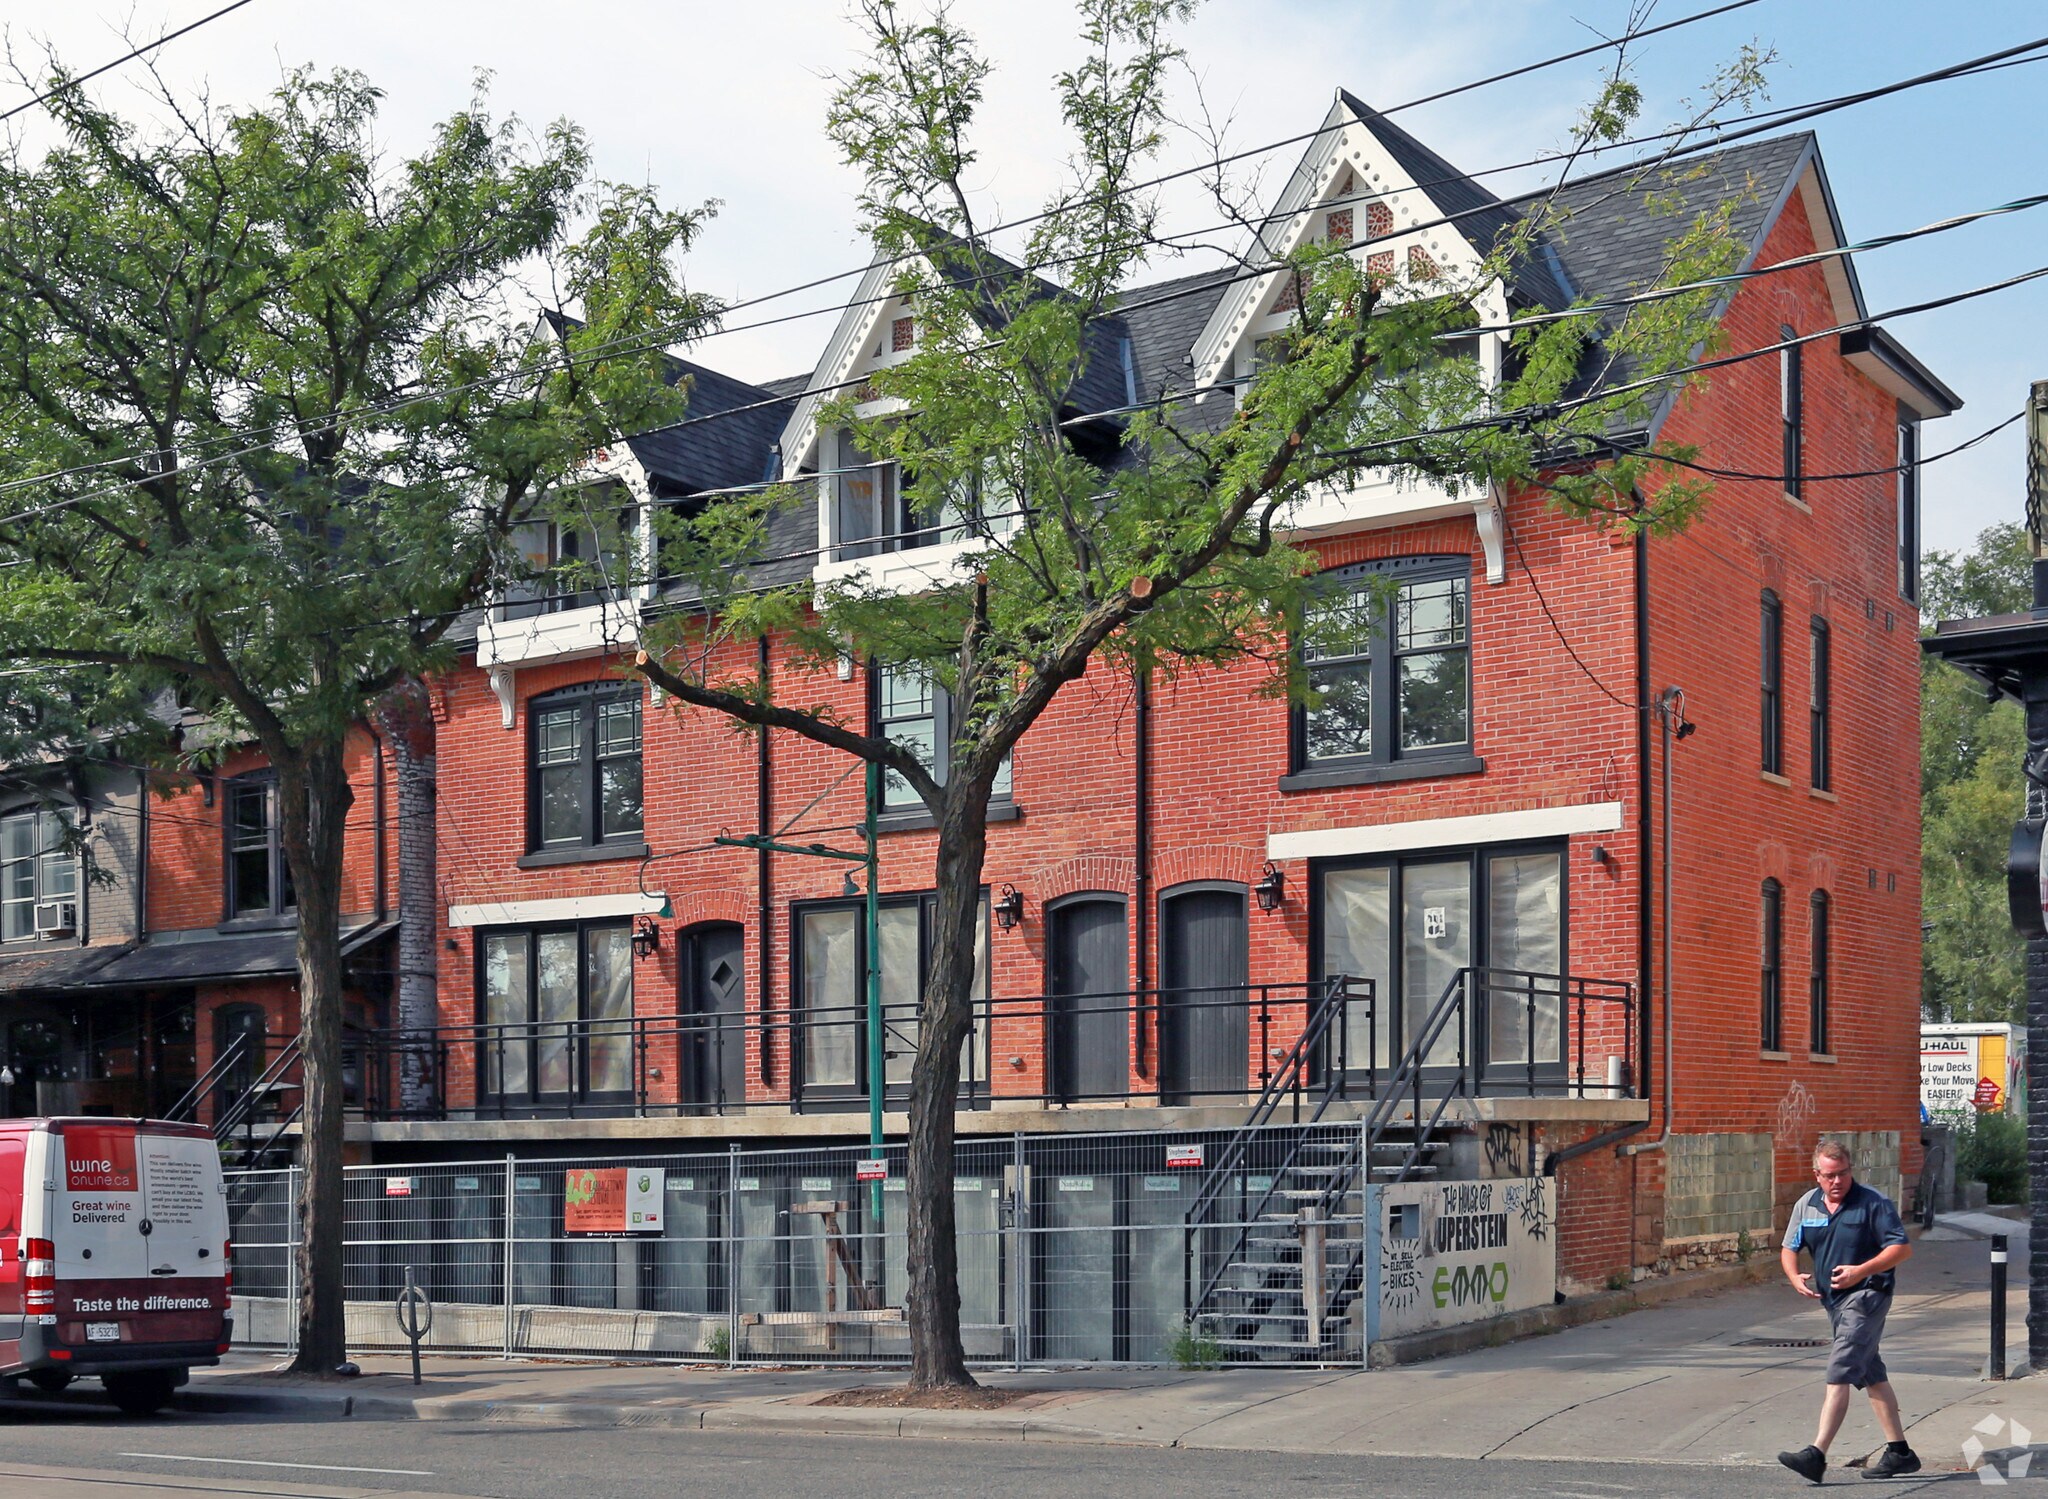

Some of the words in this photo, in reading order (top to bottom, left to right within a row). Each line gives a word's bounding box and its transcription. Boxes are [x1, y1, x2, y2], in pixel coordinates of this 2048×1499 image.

[1928, 1062, 1945, 1072] Low
[1946, 1062, 1972, 1072] Decks
[1932, 1075, 1950, 1085] Your
[70, 1160, 112, 1173] wine
[71, 1175, 130, 1186] online.ca
[72, 1200, 103, 1211] Great
[1390, 1252, 1398, 1260] WE
[1401, 1251, 1414, 1260] SELL
[1390, 1260, 1414, 1272] ELECTRIC
[1389, 1271, 1415, 1290] BIKES
[73, 1298, 113, 1312] Taste
[116, 1297, 140, 1311] the
[143, 1295, 212, 1310] difference.
